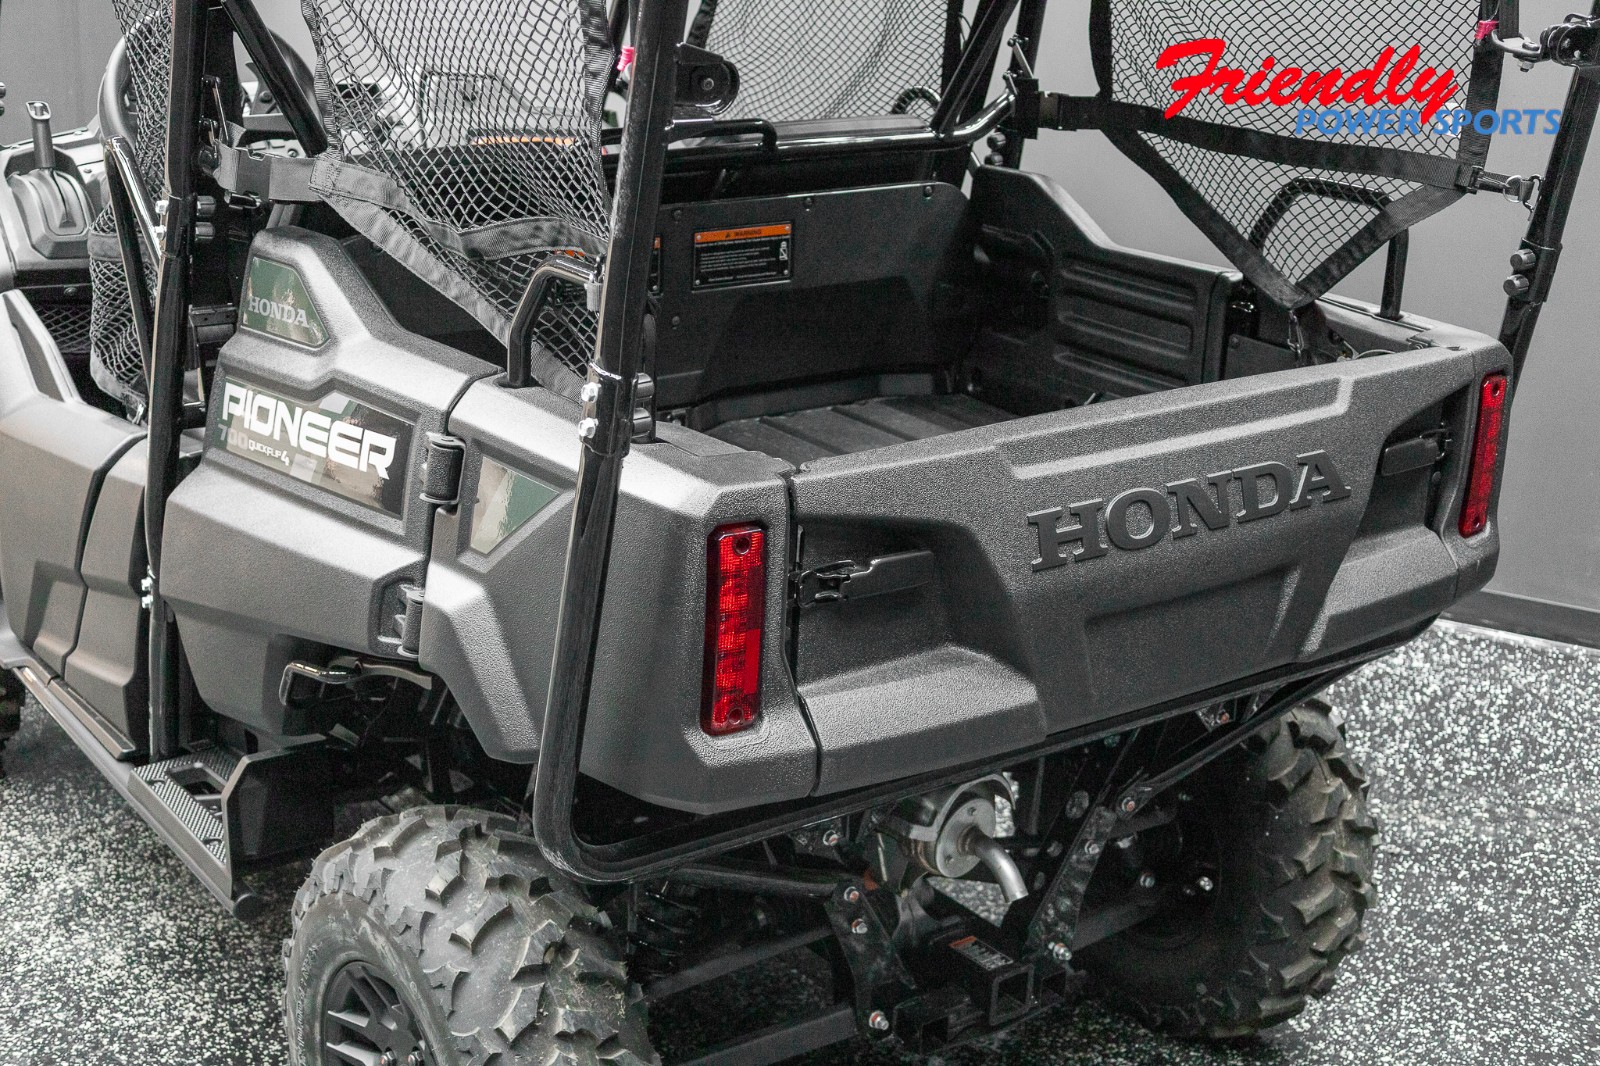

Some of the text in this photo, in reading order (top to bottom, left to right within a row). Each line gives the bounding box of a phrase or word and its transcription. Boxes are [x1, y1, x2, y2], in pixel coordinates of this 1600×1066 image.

[248, 295, 310, 328] HONDA
[217, 423, 248, 450] 700
[222, 382, 397, 480] PIONEER
[1027, 450, 1351, 572] HONDA
